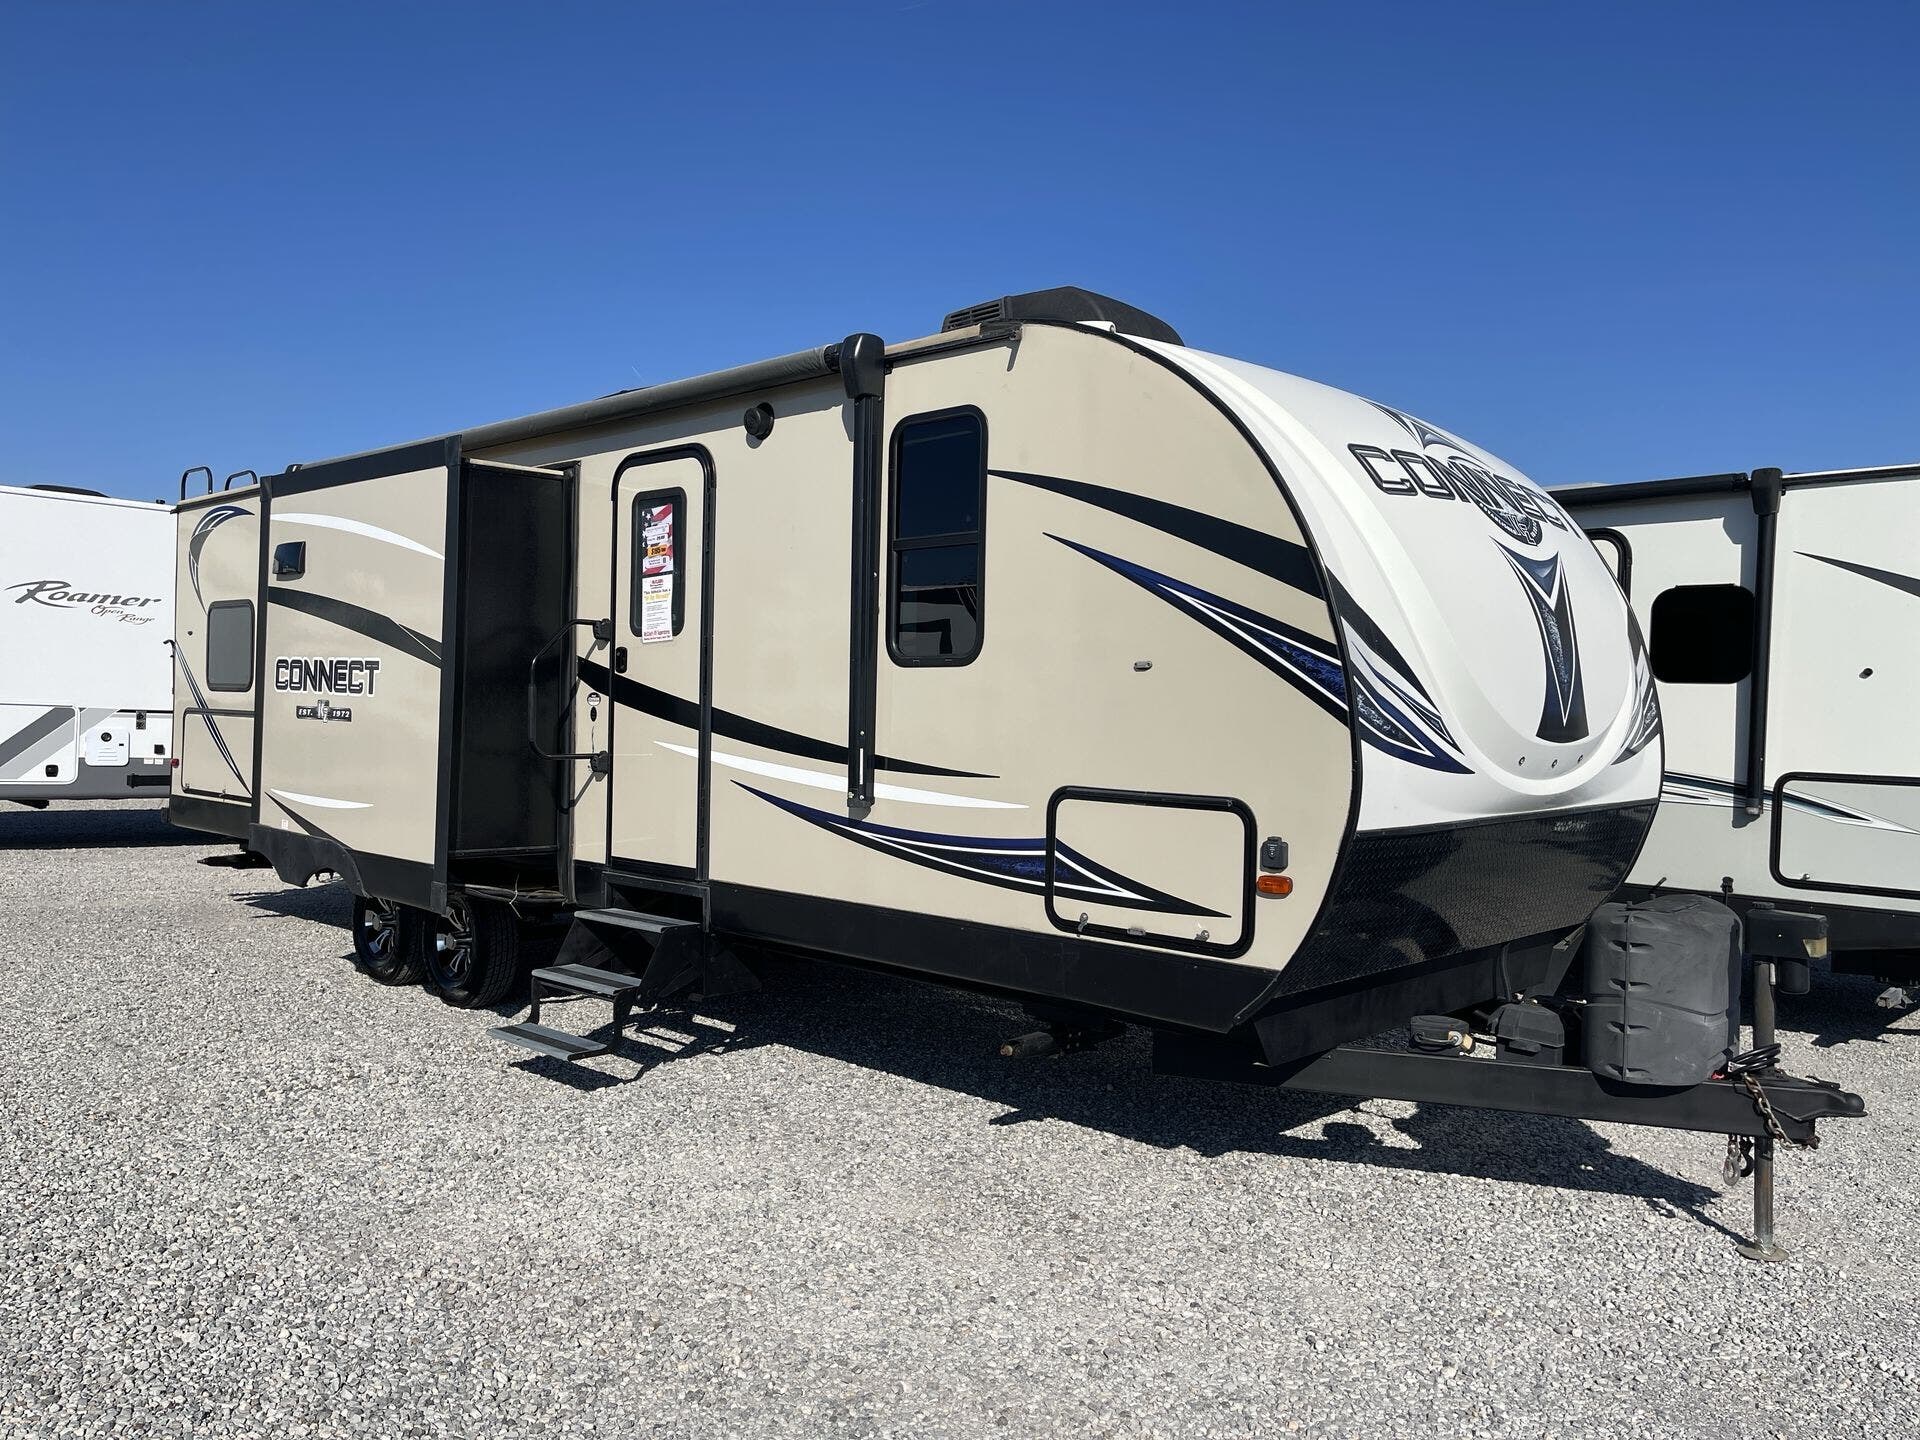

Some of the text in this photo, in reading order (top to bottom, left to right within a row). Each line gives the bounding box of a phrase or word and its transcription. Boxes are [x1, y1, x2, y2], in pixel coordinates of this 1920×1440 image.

[1347, 443, 1583, 540] CONNECT
[4, 580, 162, 608] Roamer
[91, 605, 125, 616] Open
[275, 657, 380, 696] CONNECT
[298, 708, 313, 716] EST.
[332, 710, 350, 718] 1972
